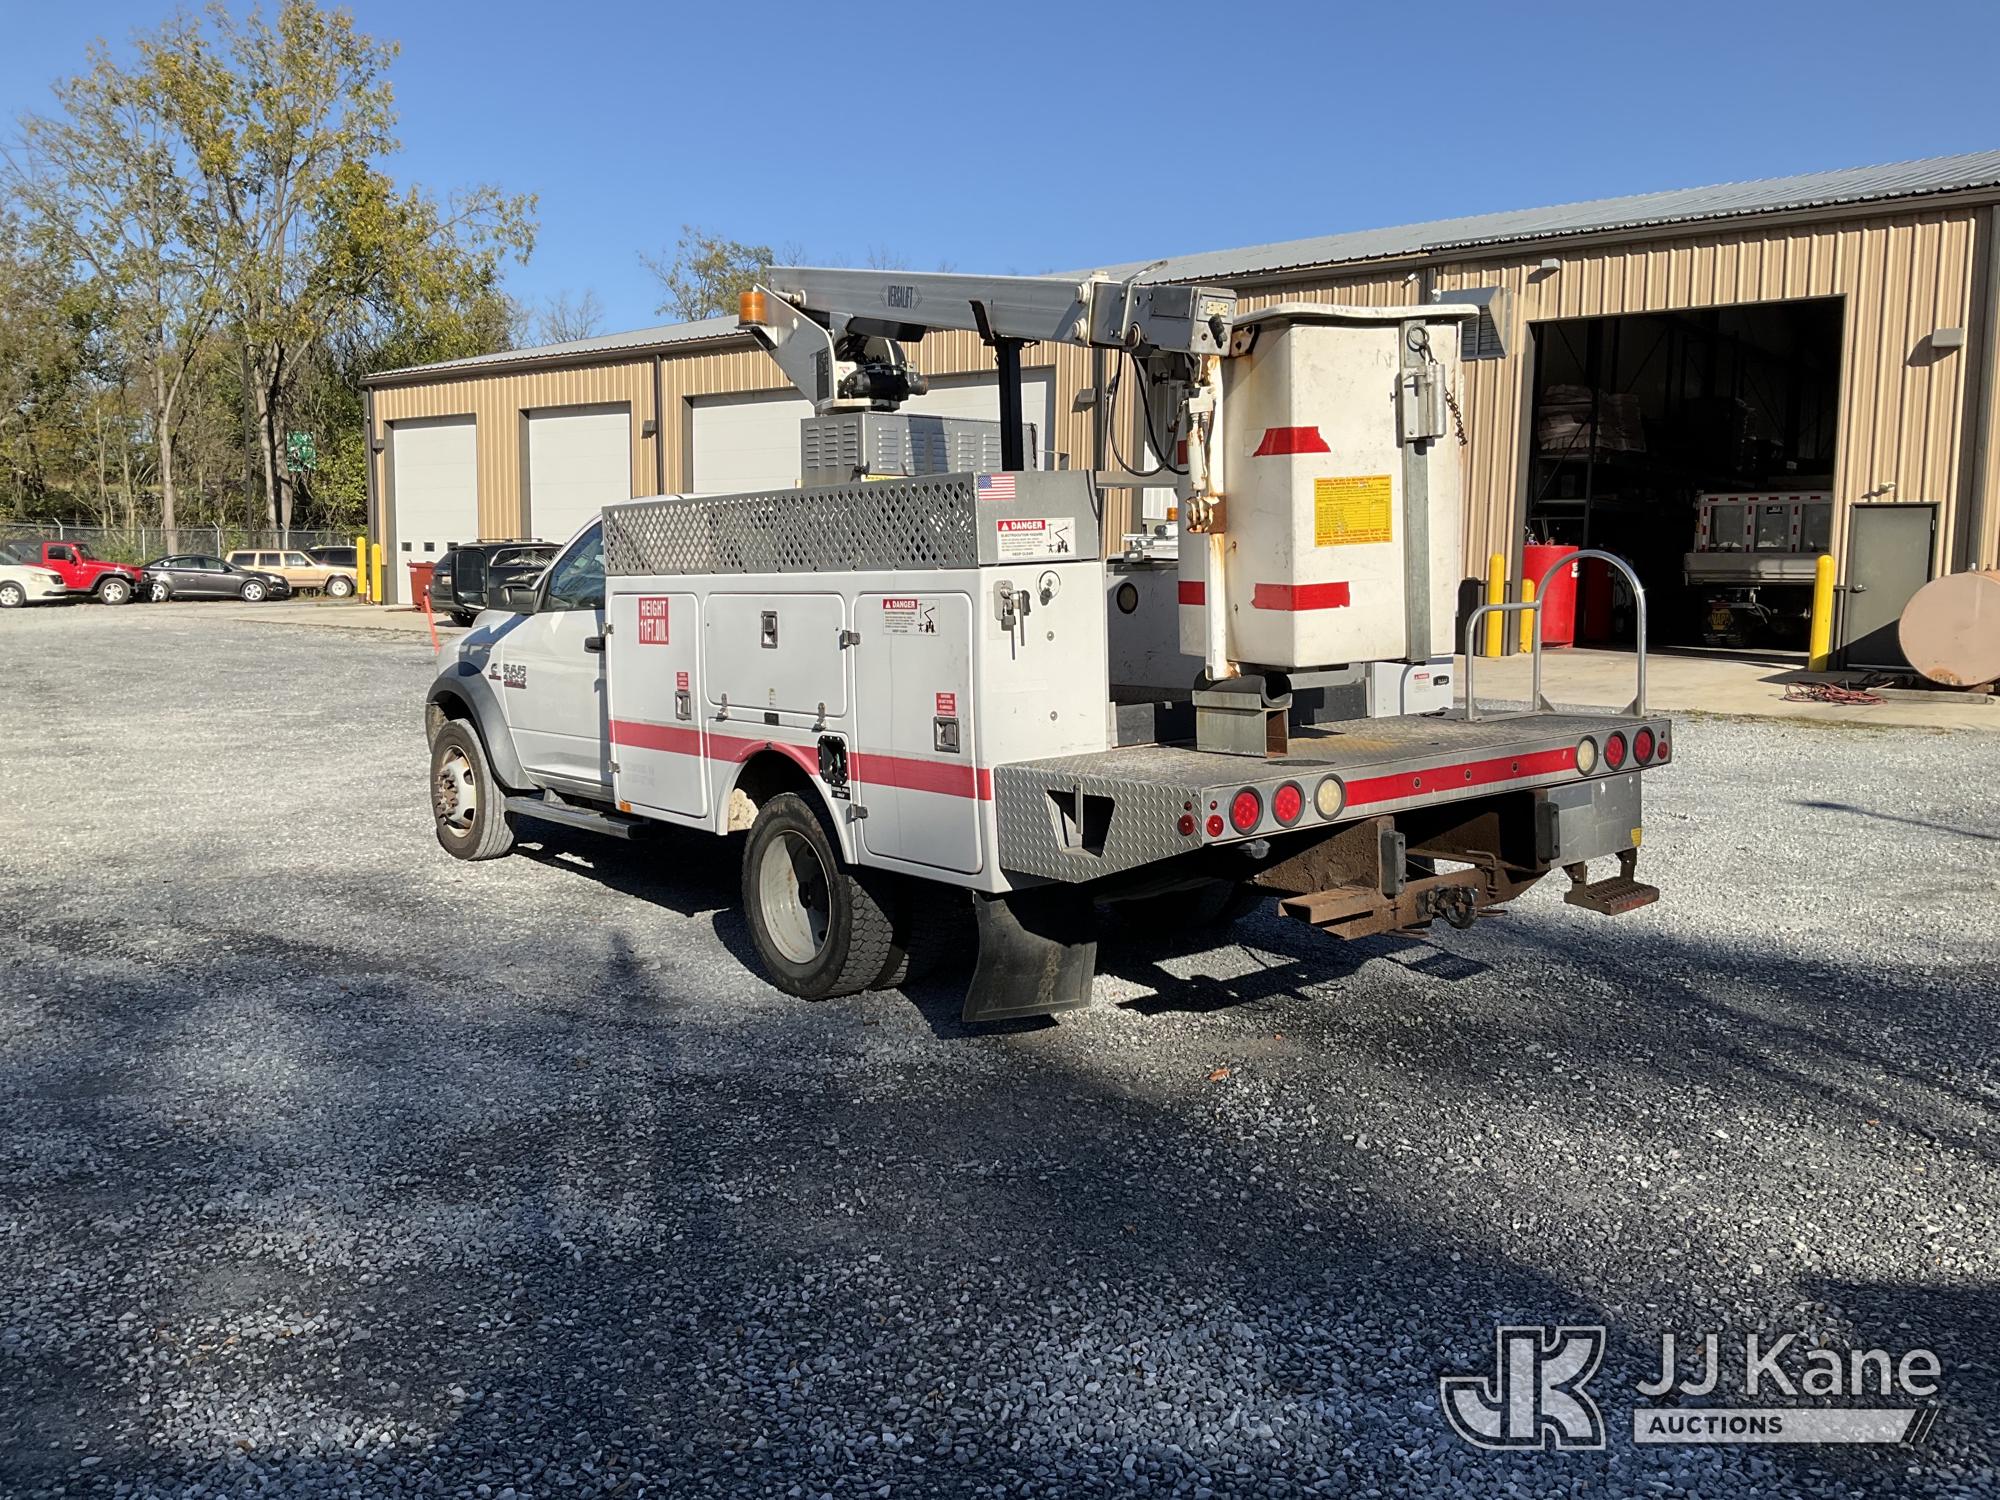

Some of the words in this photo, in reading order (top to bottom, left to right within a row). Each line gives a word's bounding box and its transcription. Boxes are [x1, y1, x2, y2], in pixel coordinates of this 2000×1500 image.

[888, 285, 913, 309] VERSALIFT
[1010, 520, 1043, 530] DANGER
[640, 599, 667, 617] HEIGHT
[892, 600, 916, 609] DANGER
